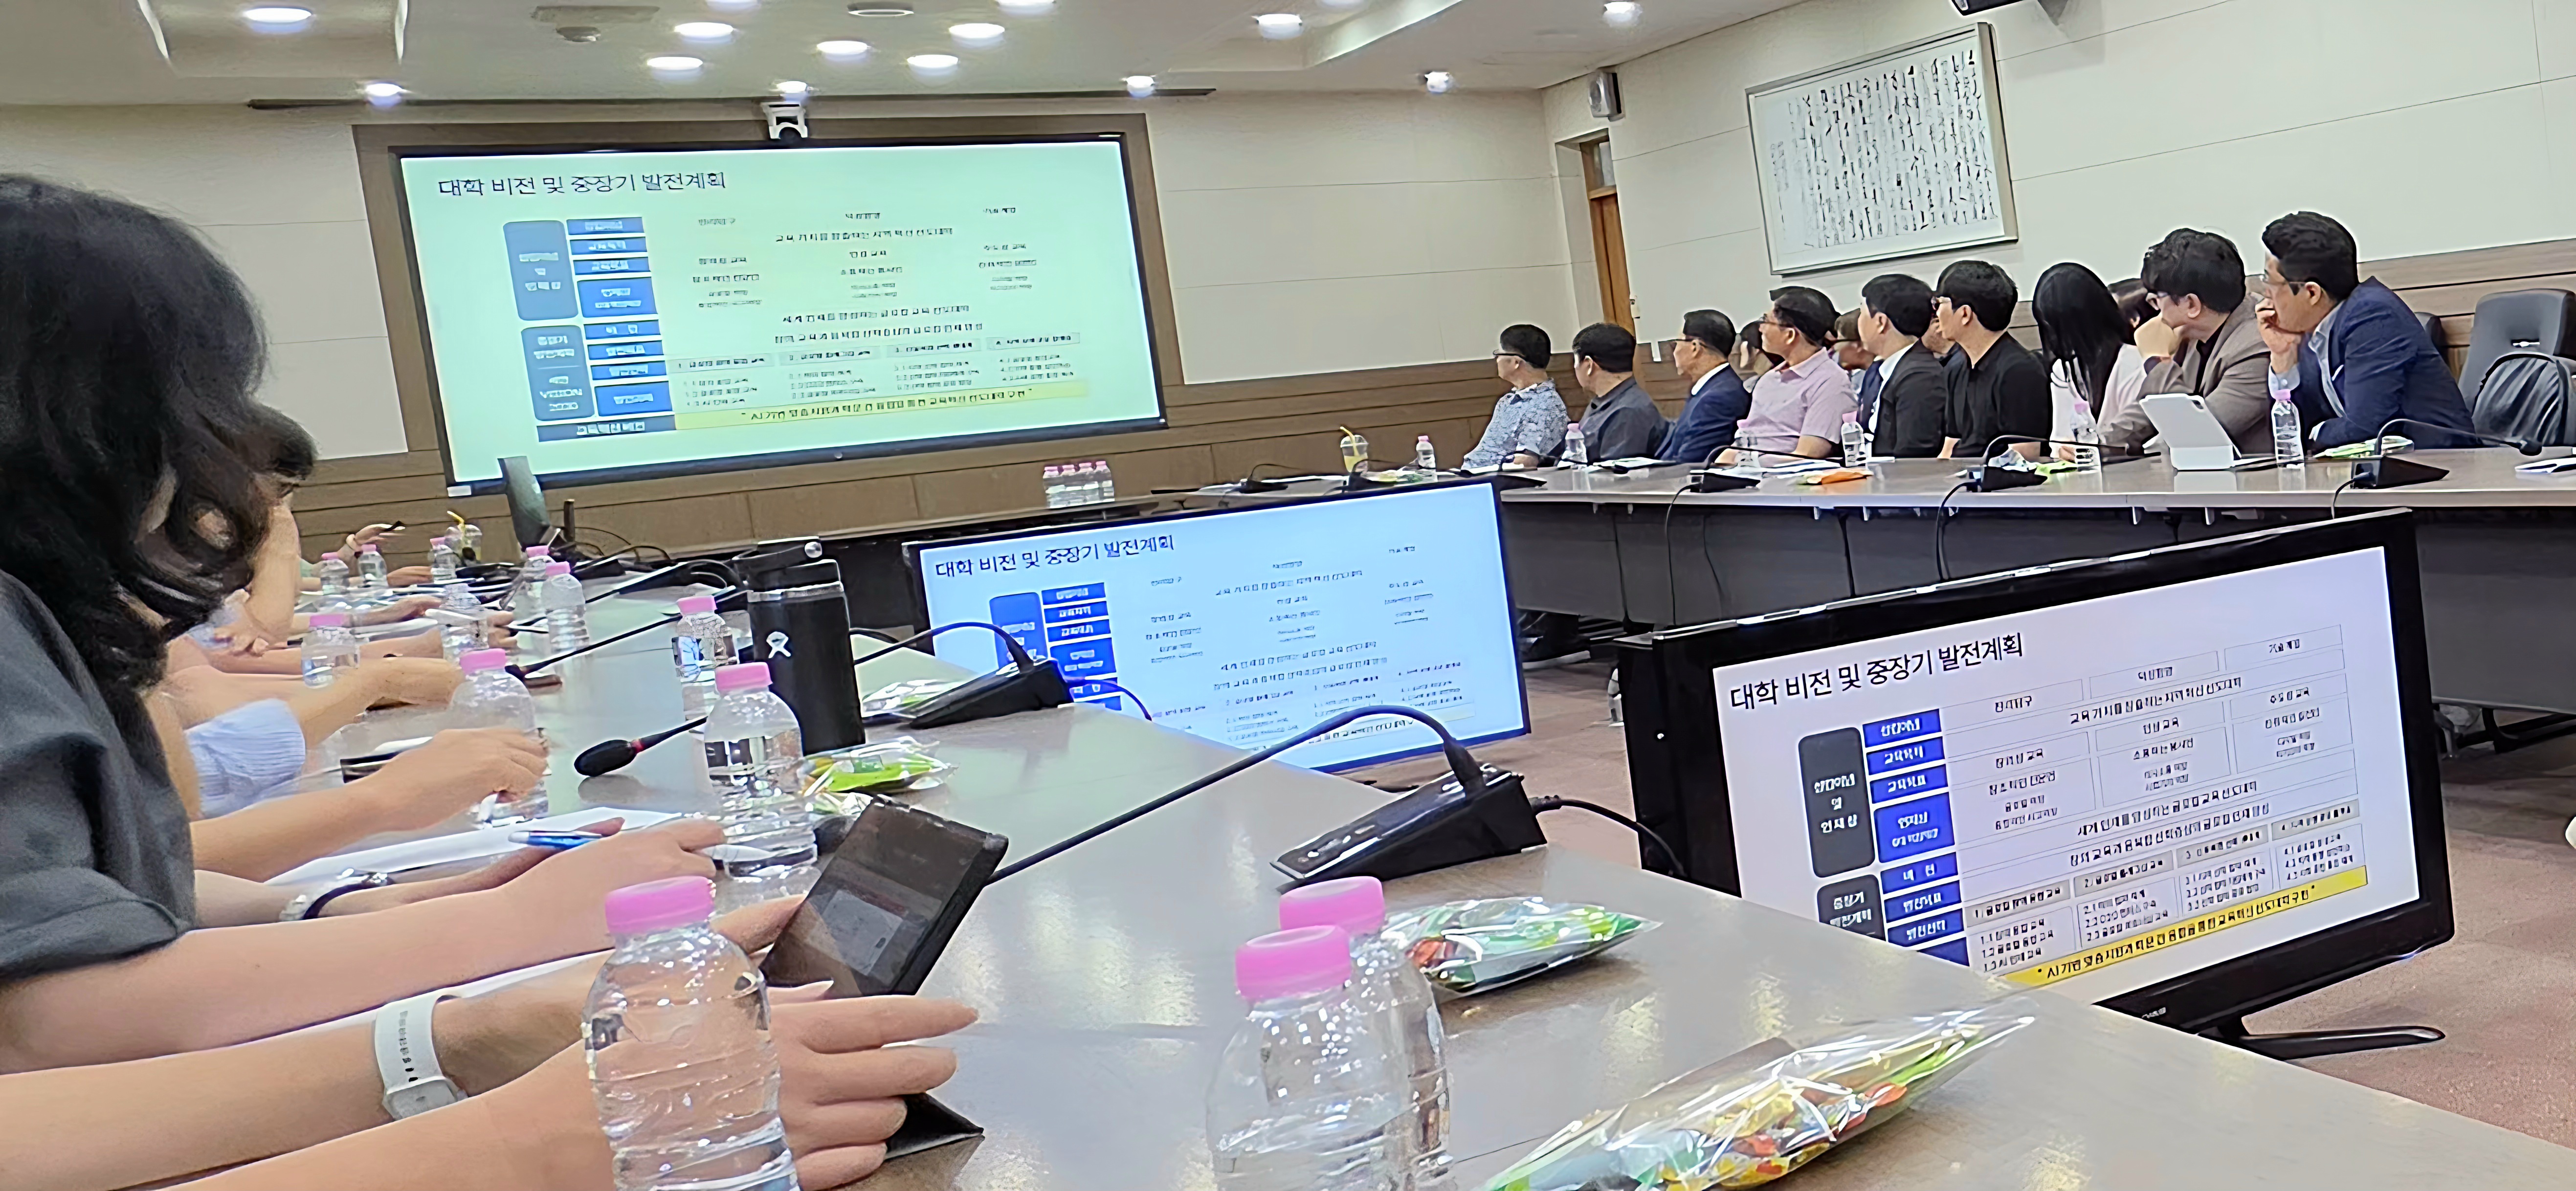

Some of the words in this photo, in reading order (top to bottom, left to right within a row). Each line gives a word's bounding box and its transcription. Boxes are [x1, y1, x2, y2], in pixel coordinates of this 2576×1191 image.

[438, 178, 485, 196] 대학
[491, 176, 536, 196] 비전
[542, 176, 565, 194] 및
[570, 174, 636, 193] 중장기
[641, 171, 726, 191] 발전계획
[935, 558, 973, 577] 대학
[979, 553, 1017, 573] 비전
[1021, 550, 1040, 569] 및
[1044, 543, 1099, 565] 중장기
[1103, 534, 1174, 557] 발전계획
[1730, 678, 1778, 709] 대학
[1785, 668, 1832, 699] 비전
[1838, 662, 1862, 691] 및
[1866, 649, 1932, 685] 중장기
[1938, 632, 2022, 672] 발전계획
